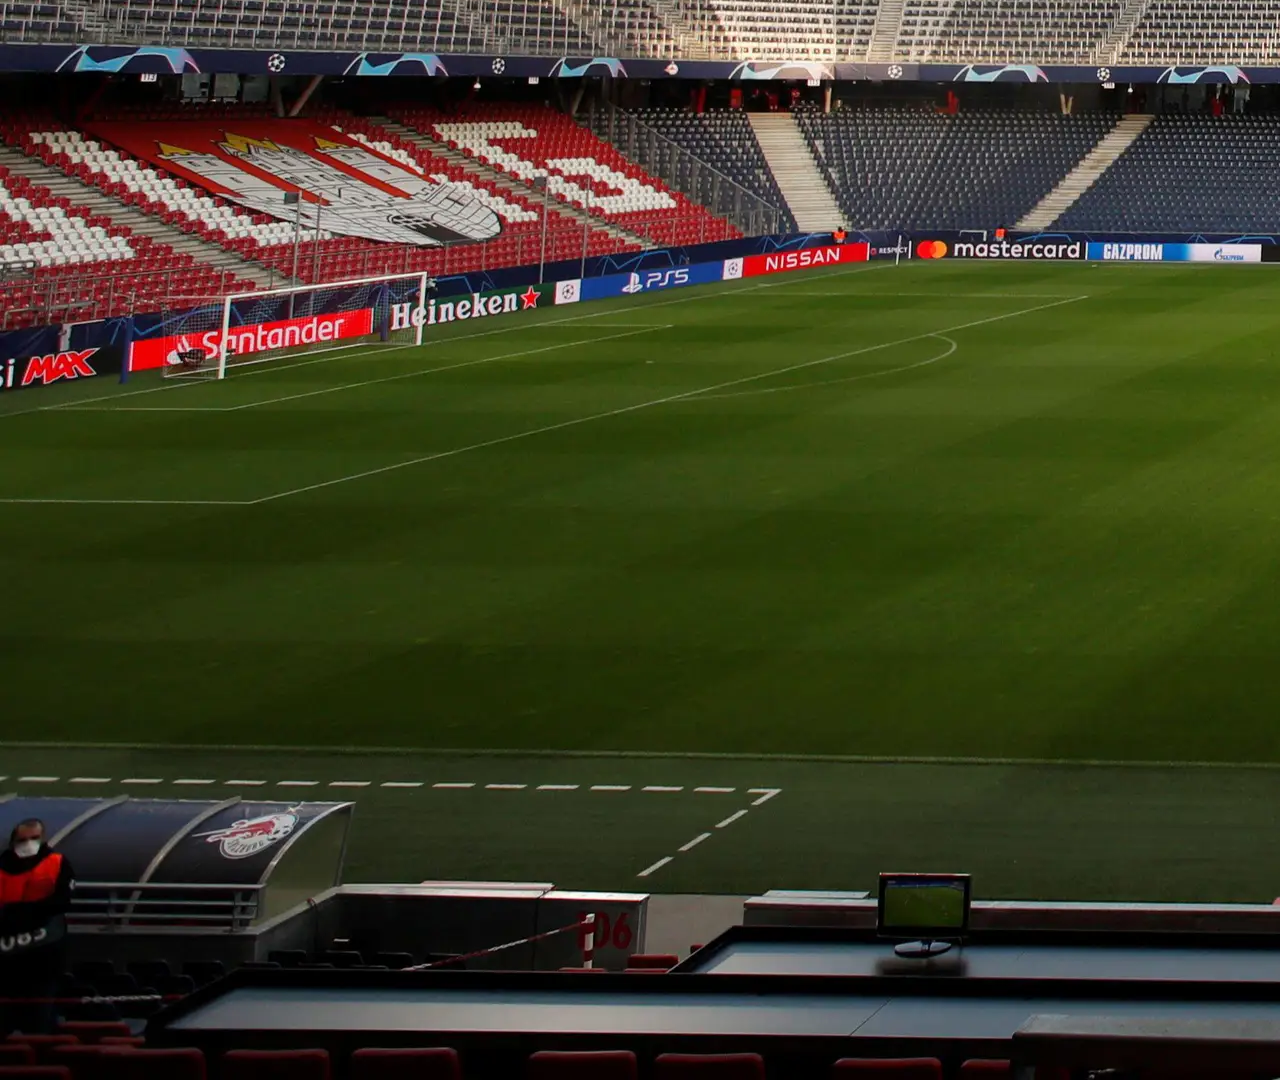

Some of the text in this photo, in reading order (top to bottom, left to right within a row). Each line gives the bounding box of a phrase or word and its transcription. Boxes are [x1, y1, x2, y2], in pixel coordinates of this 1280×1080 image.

[765, 247, 841, 271] NISSAN
[953, 242, 1080, 258] mastercard
[1103, 243, 1163, 260] GAZPROM
[646, 269, 689, 287] PS5
[391, 293, 518, 331] Heineken
[203, 316, 345, 358] Santander
[20, 346, 100, 387] MAX
